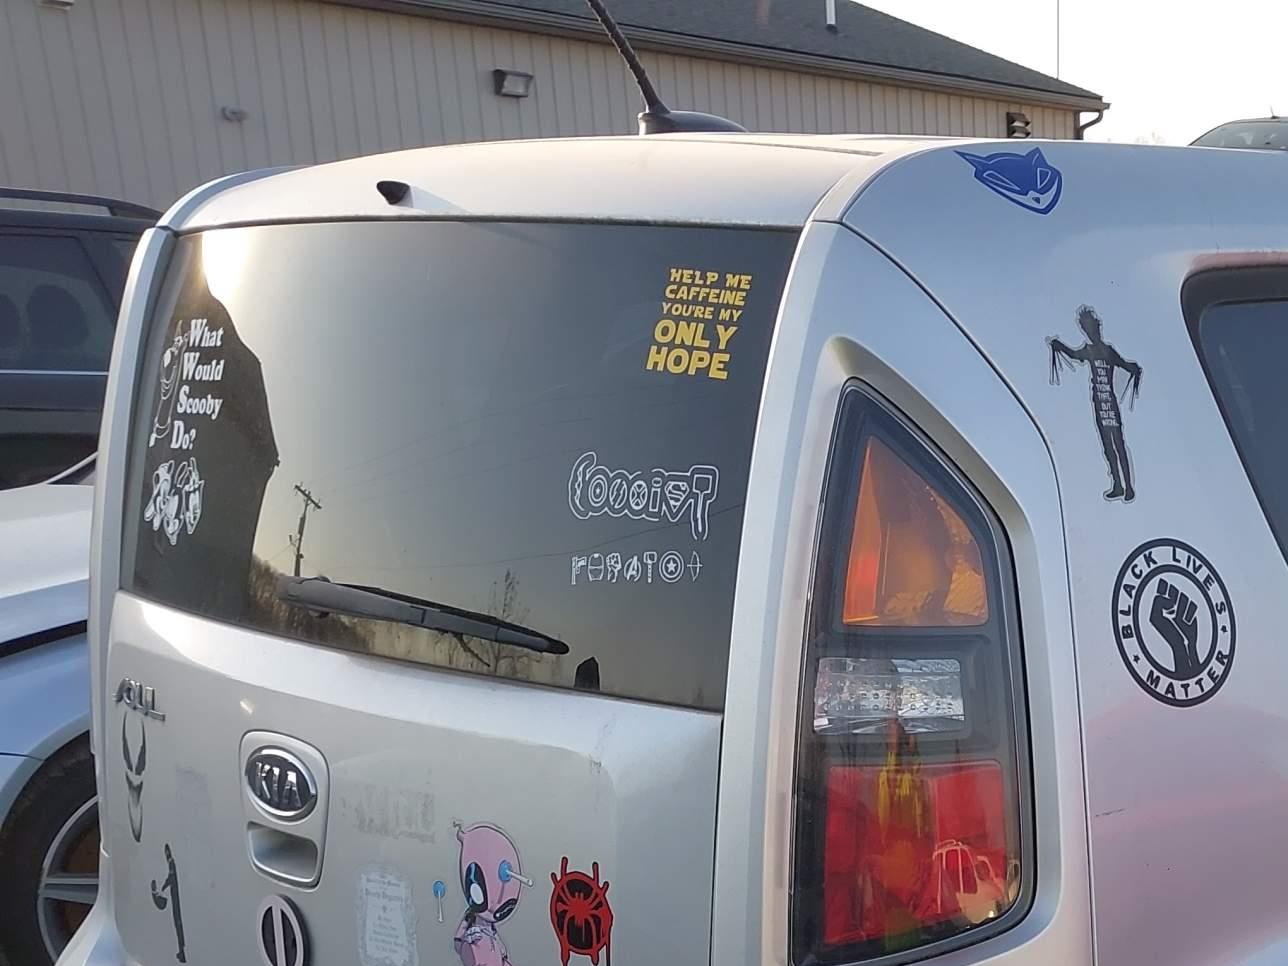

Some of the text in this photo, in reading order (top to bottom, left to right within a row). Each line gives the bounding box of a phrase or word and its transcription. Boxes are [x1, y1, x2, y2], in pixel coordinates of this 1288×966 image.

[670, 268, 752, 290] HELP ME
[665, 284, 747, 306] CAFFEINE
[662, 302, 743, 322] YOU'RE MY
[189, 318, 224, 347] What
[654, 319, 738, 350] ONLY
[182, 352, 225, 380] Would
[646, 345, 731, 380] HOPE
[177, 385, 223, 420] Scooby
[170, 420, 196, 450] Do?
[1119, 546, 1227, 640] BLACK LIVES
[1146, 650, 1229, 700] MATTER
[255, 761, 303, 810] KIA
